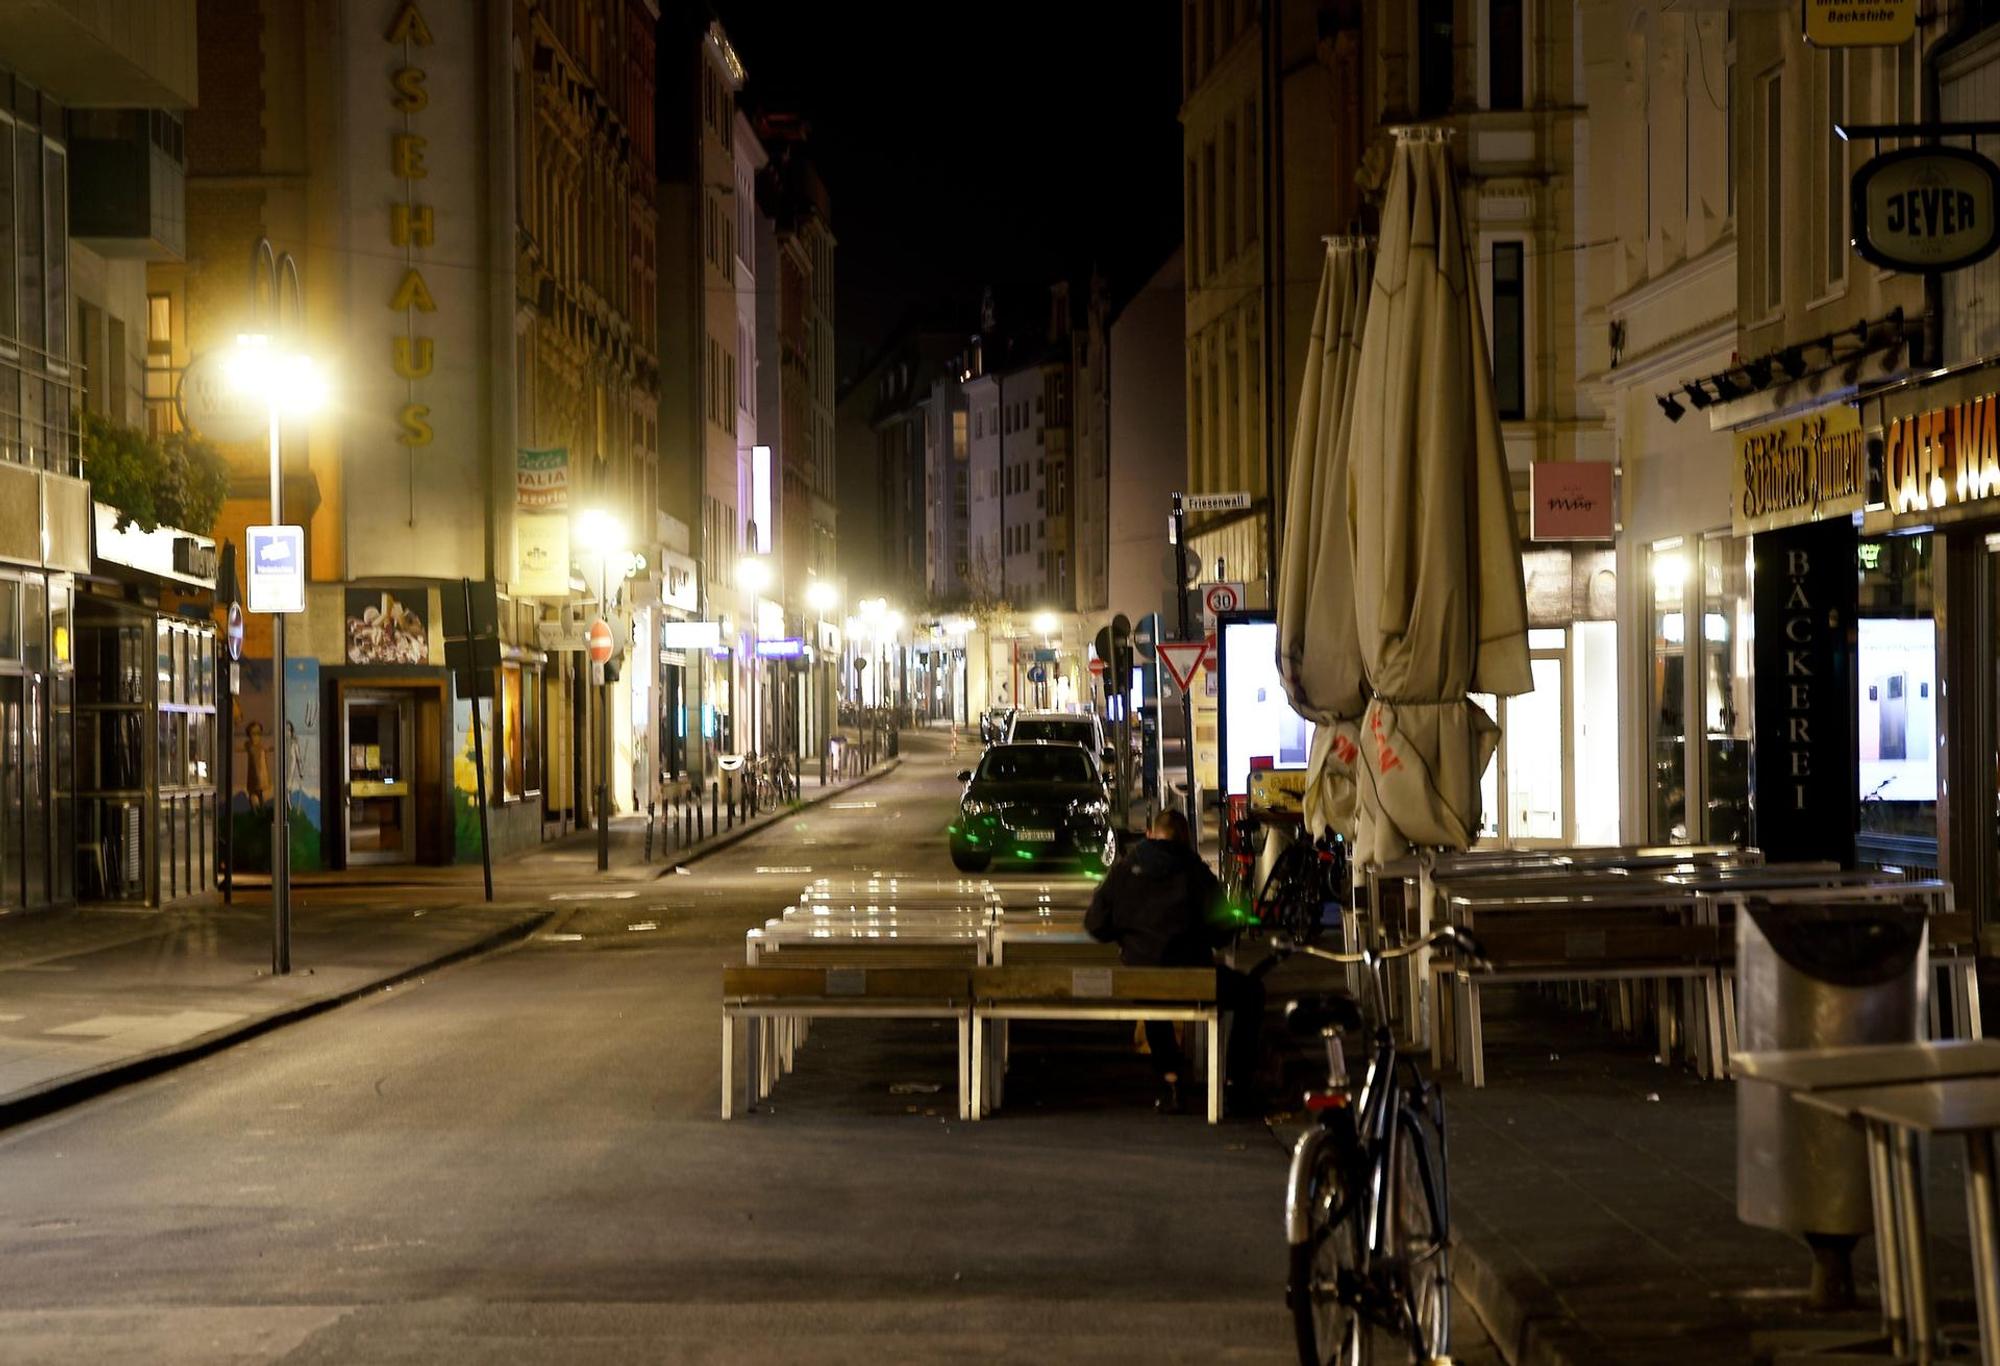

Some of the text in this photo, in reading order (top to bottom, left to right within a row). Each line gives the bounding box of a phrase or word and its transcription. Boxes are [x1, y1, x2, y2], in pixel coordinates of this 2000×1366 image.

[1828, 9, 1895, 23] Backstube
[1887, 187, 1975, 237] JEVER
[1188, 495, 1245, 510] Friesenwall
[1212, 592, 1231, 610] 30
[1785, 550, 1813, 810] BÄCKEREI
